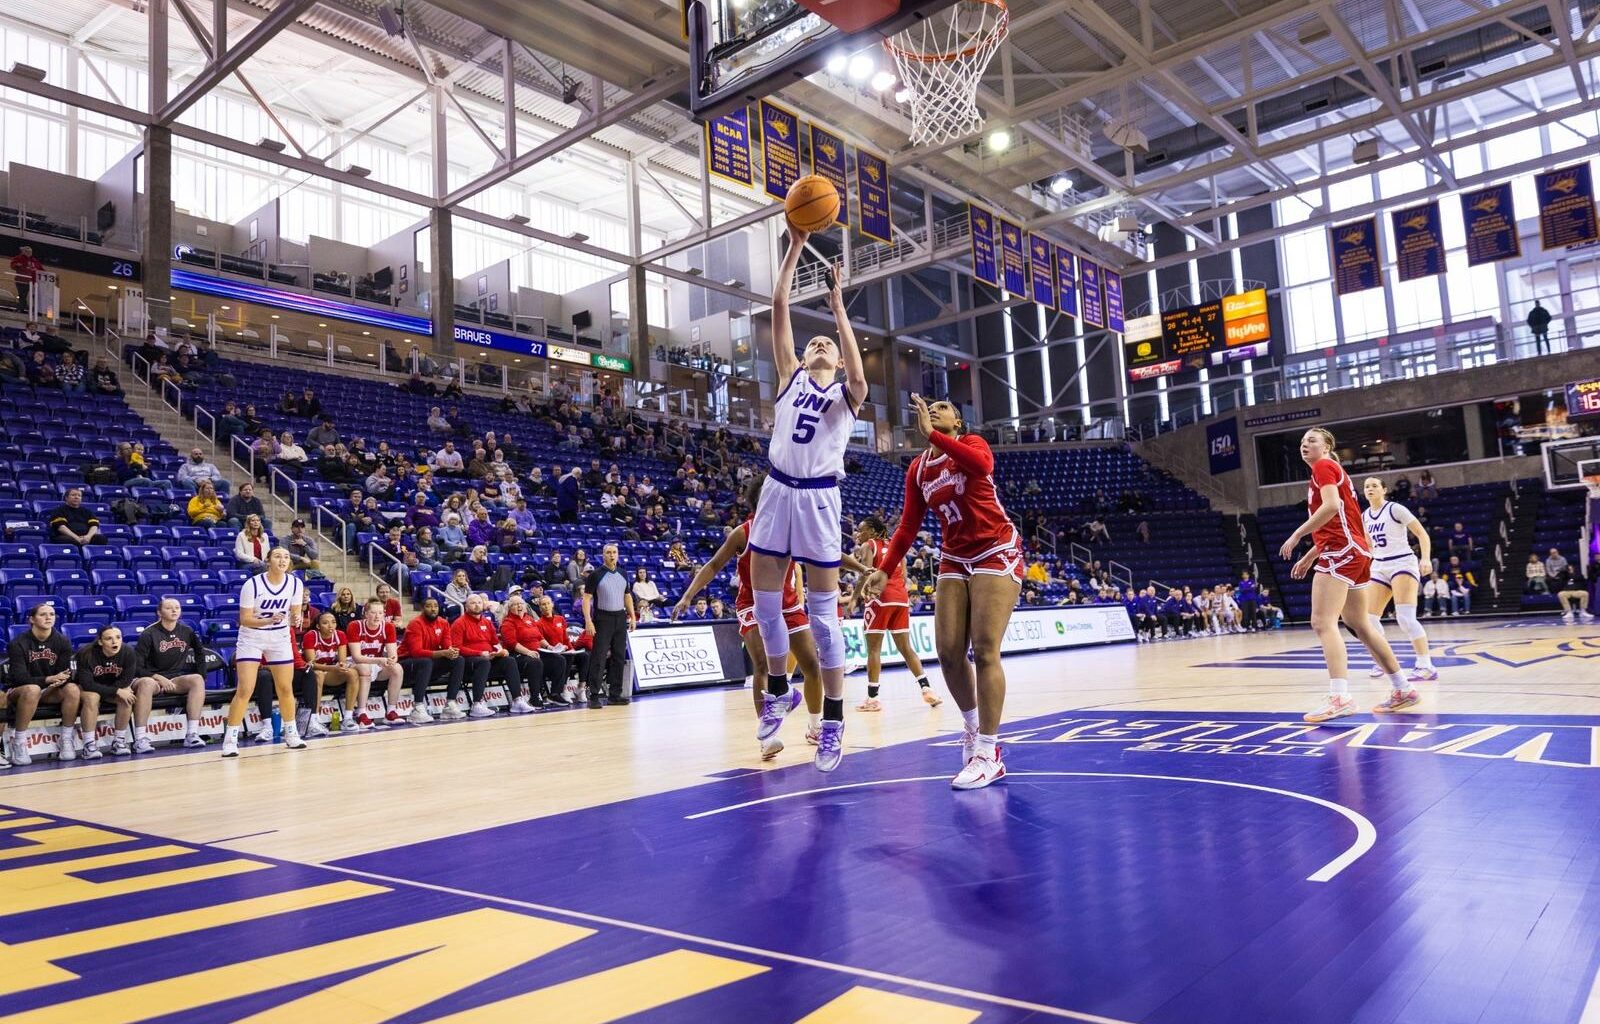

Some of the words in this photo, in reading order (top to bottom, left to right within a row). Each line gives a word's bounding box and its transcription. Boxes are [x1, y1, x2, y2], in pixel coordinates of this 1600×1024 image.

[717, 122, 742, 140] NCAA
[112, 261, 133, 277] 26
[38, 273, 55, 283] 113
[126, 289, 143, 298] 114
[1167, 322, 1176, 330] 26
[1182, 316, 1201, 327] 4:44
[1208, 313, 1216, 321] 27
[454, 327, 492, 345] BRAVES
[530, 342, 543, 355] 27
[792, 391, 834, 414] UNI
[1247, 415, 1285, 426] GALLAGHER
[1287, 410, 1318, 420] TERRACE
[791, 413, 821, 445] 5
[1211, 434, 1232, 456] 150
[938, 500, 963, 526] 21
[1368, 522, 1385, 533] UNI
[1372, 534, 1387, 548] 15
[260, 598, 288, 610] UNI
[159, 638, 187, 653] Bradley
[652, 637, 696, 650] ELITE
[645, 649, 708, 663] CASINO
[643, 660, 715, 676] RESORTS
